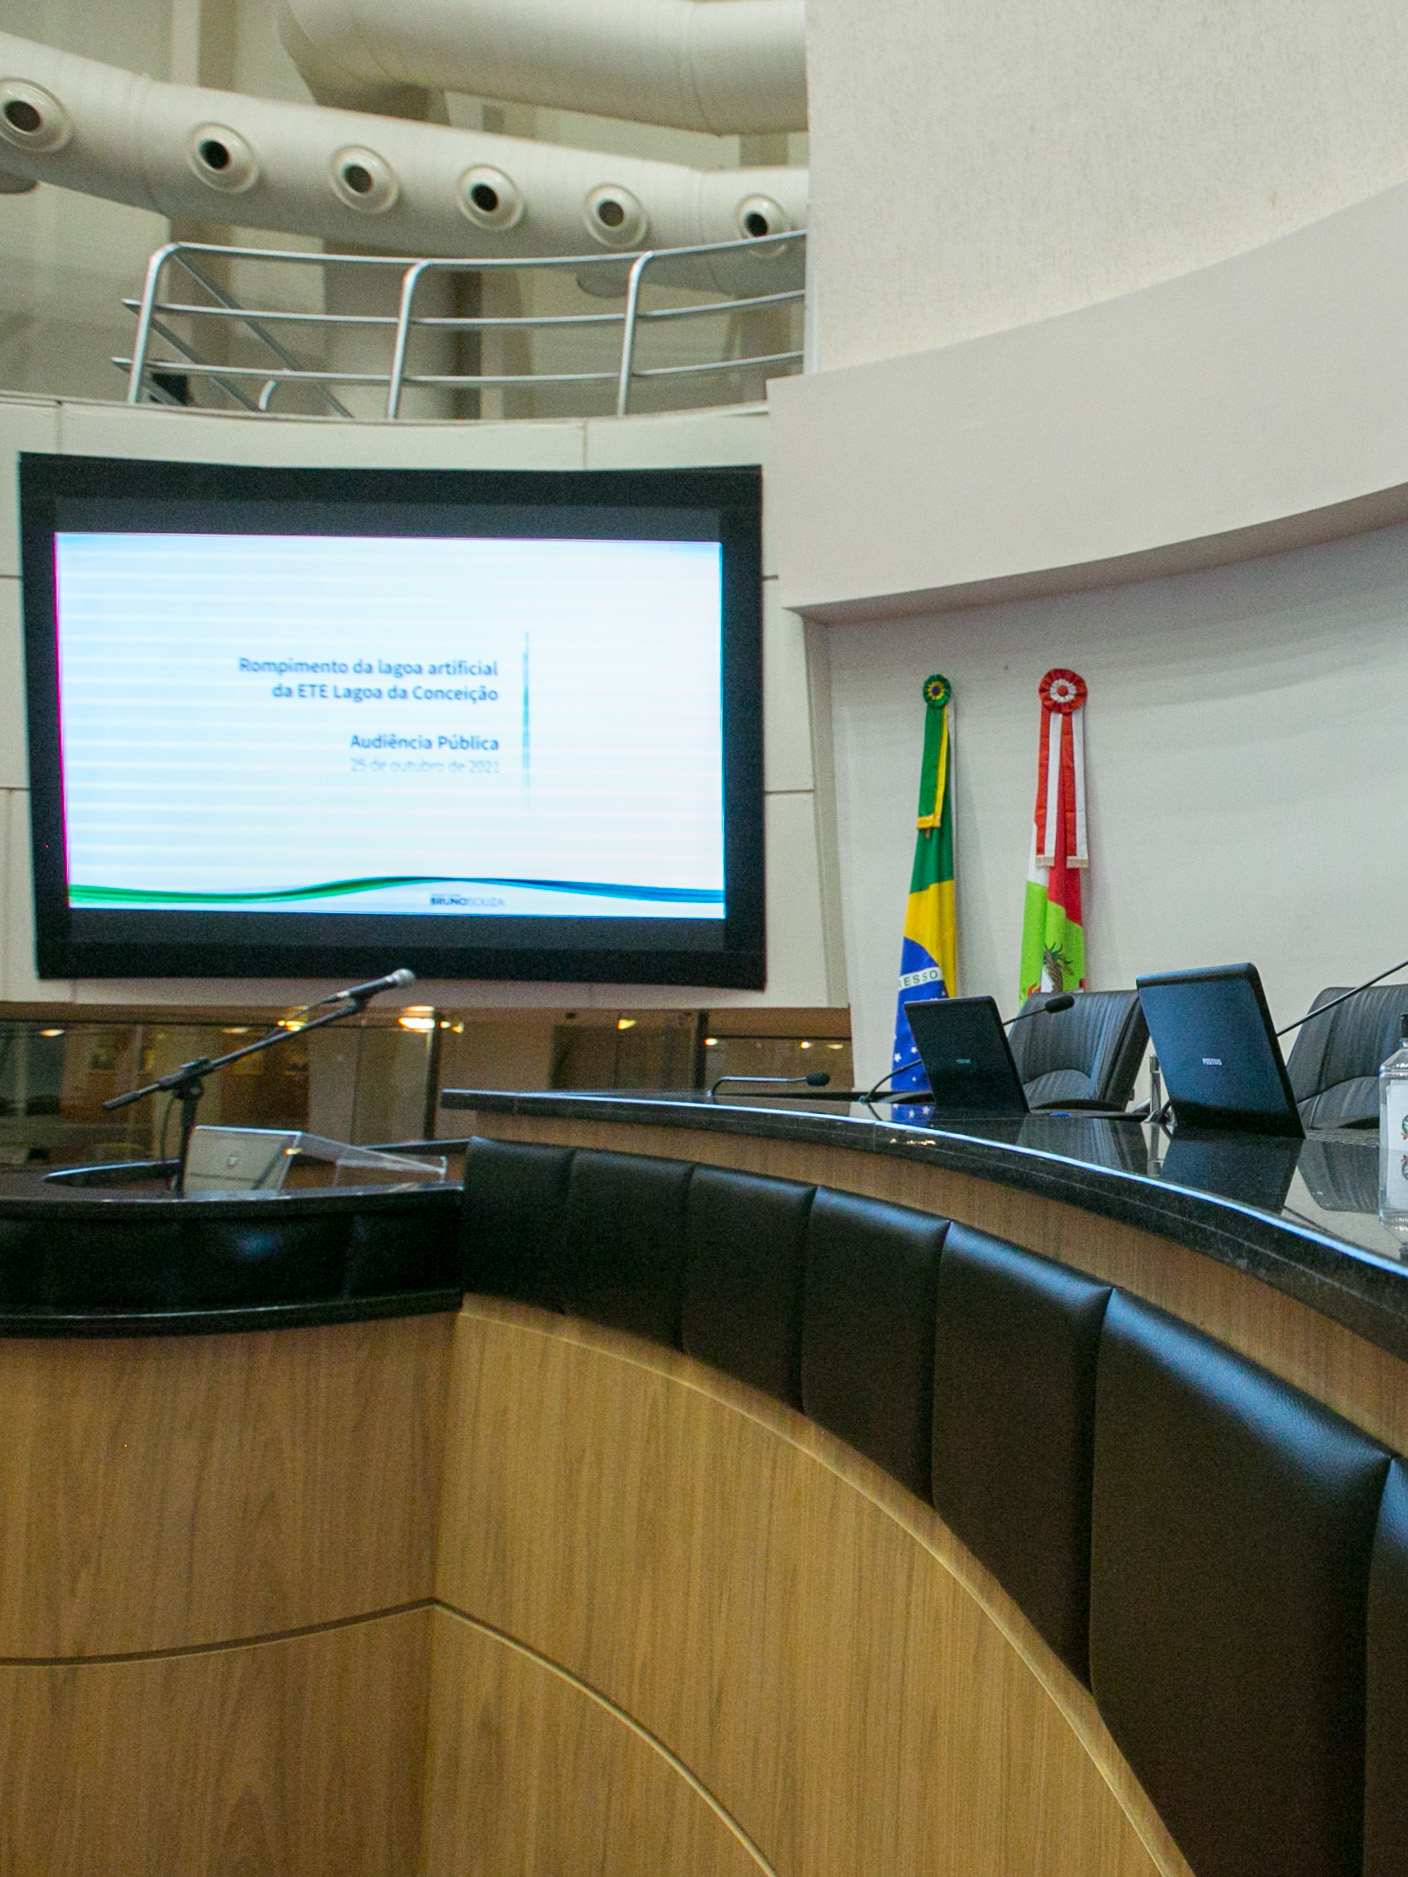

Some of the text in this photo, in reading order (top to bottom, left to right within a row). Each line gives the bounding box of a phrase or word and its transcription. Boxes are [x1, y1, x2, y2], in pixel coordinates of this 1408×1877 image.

[238, 657, 499, 678] Rompimento da lagoa artificial
[272, 683, 499, 704] da ETE Lagoa da Conceição
[350, 733, 499, 751] Audiência Pública
[350, 758, 500, 774] 25 de outubro de 2021
